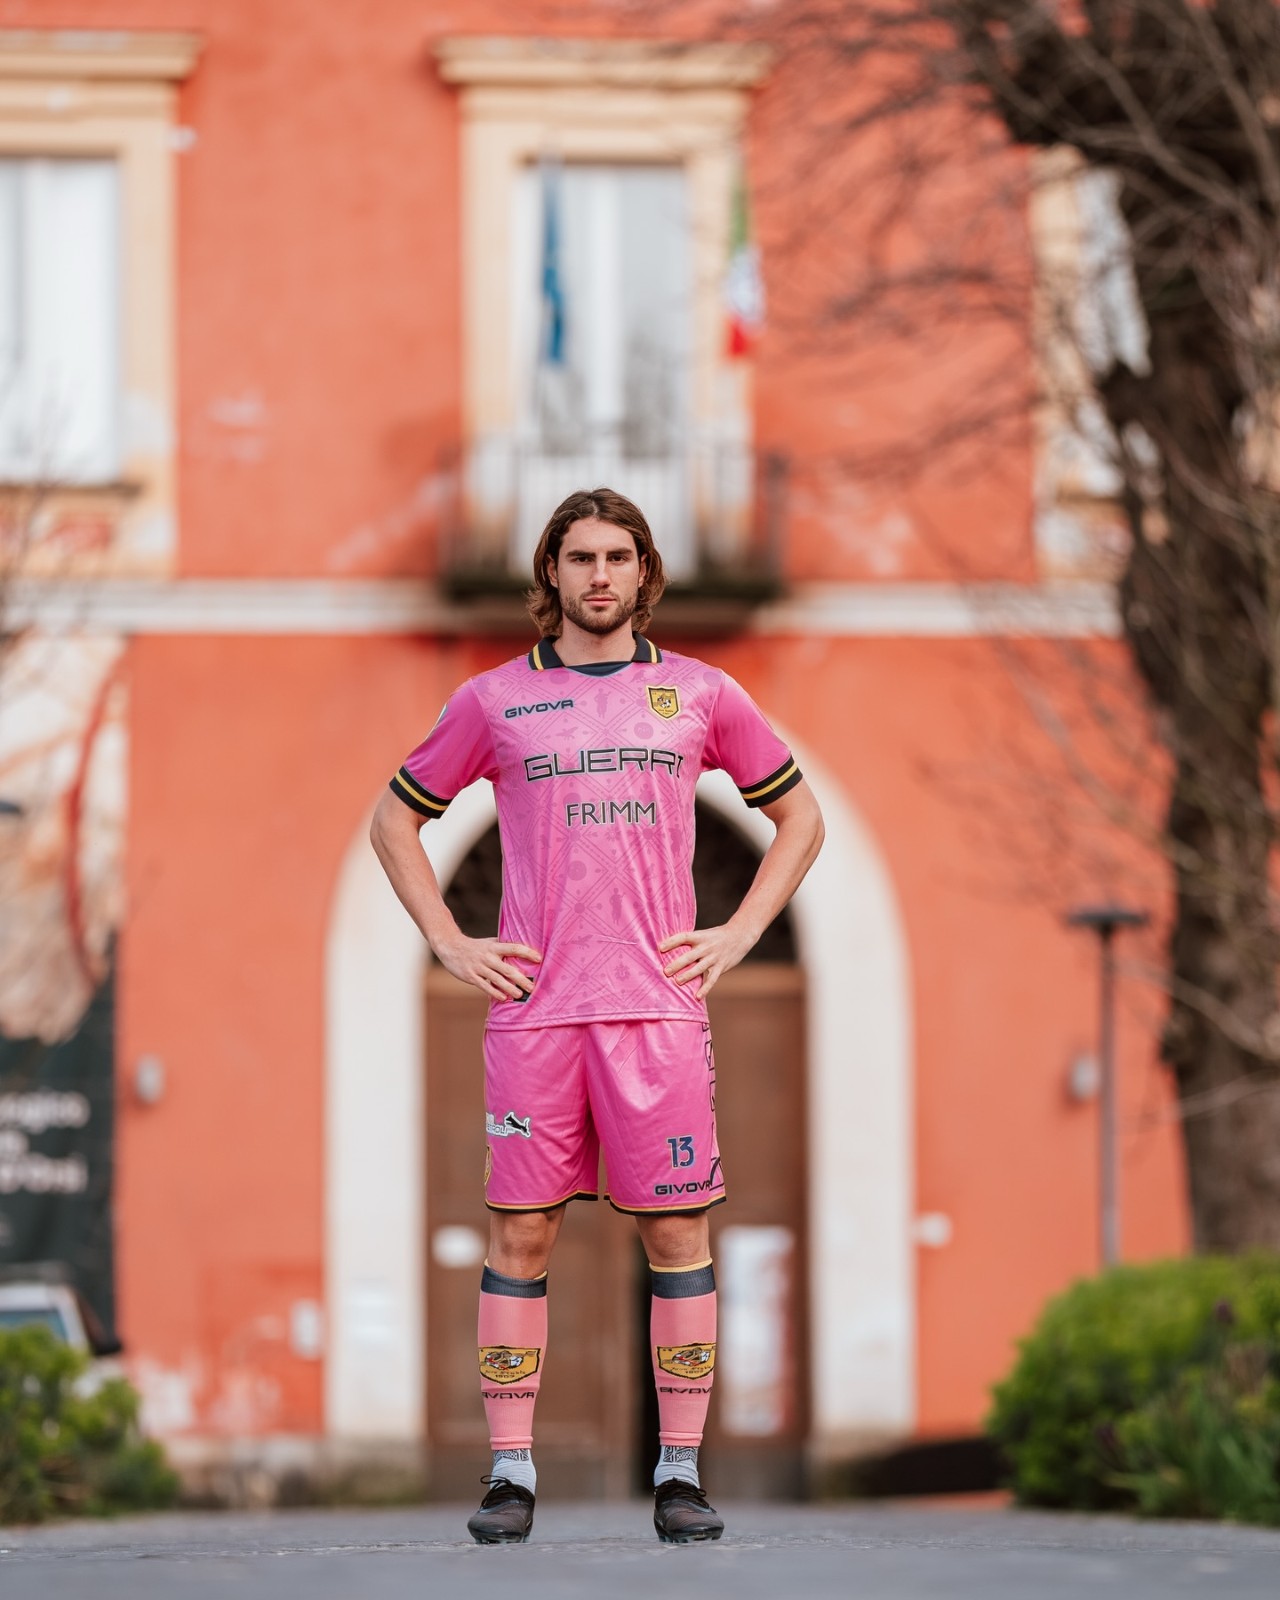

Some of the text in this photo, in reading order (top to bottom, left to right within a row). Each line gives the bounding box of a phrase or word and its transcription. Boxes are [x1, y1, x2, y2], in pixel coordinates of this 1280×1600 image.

[504, 699, 574, 719] GIVOVA
[566, 801, 656, 827] FRIMM
[667, 1136, 694, 1168] 13
